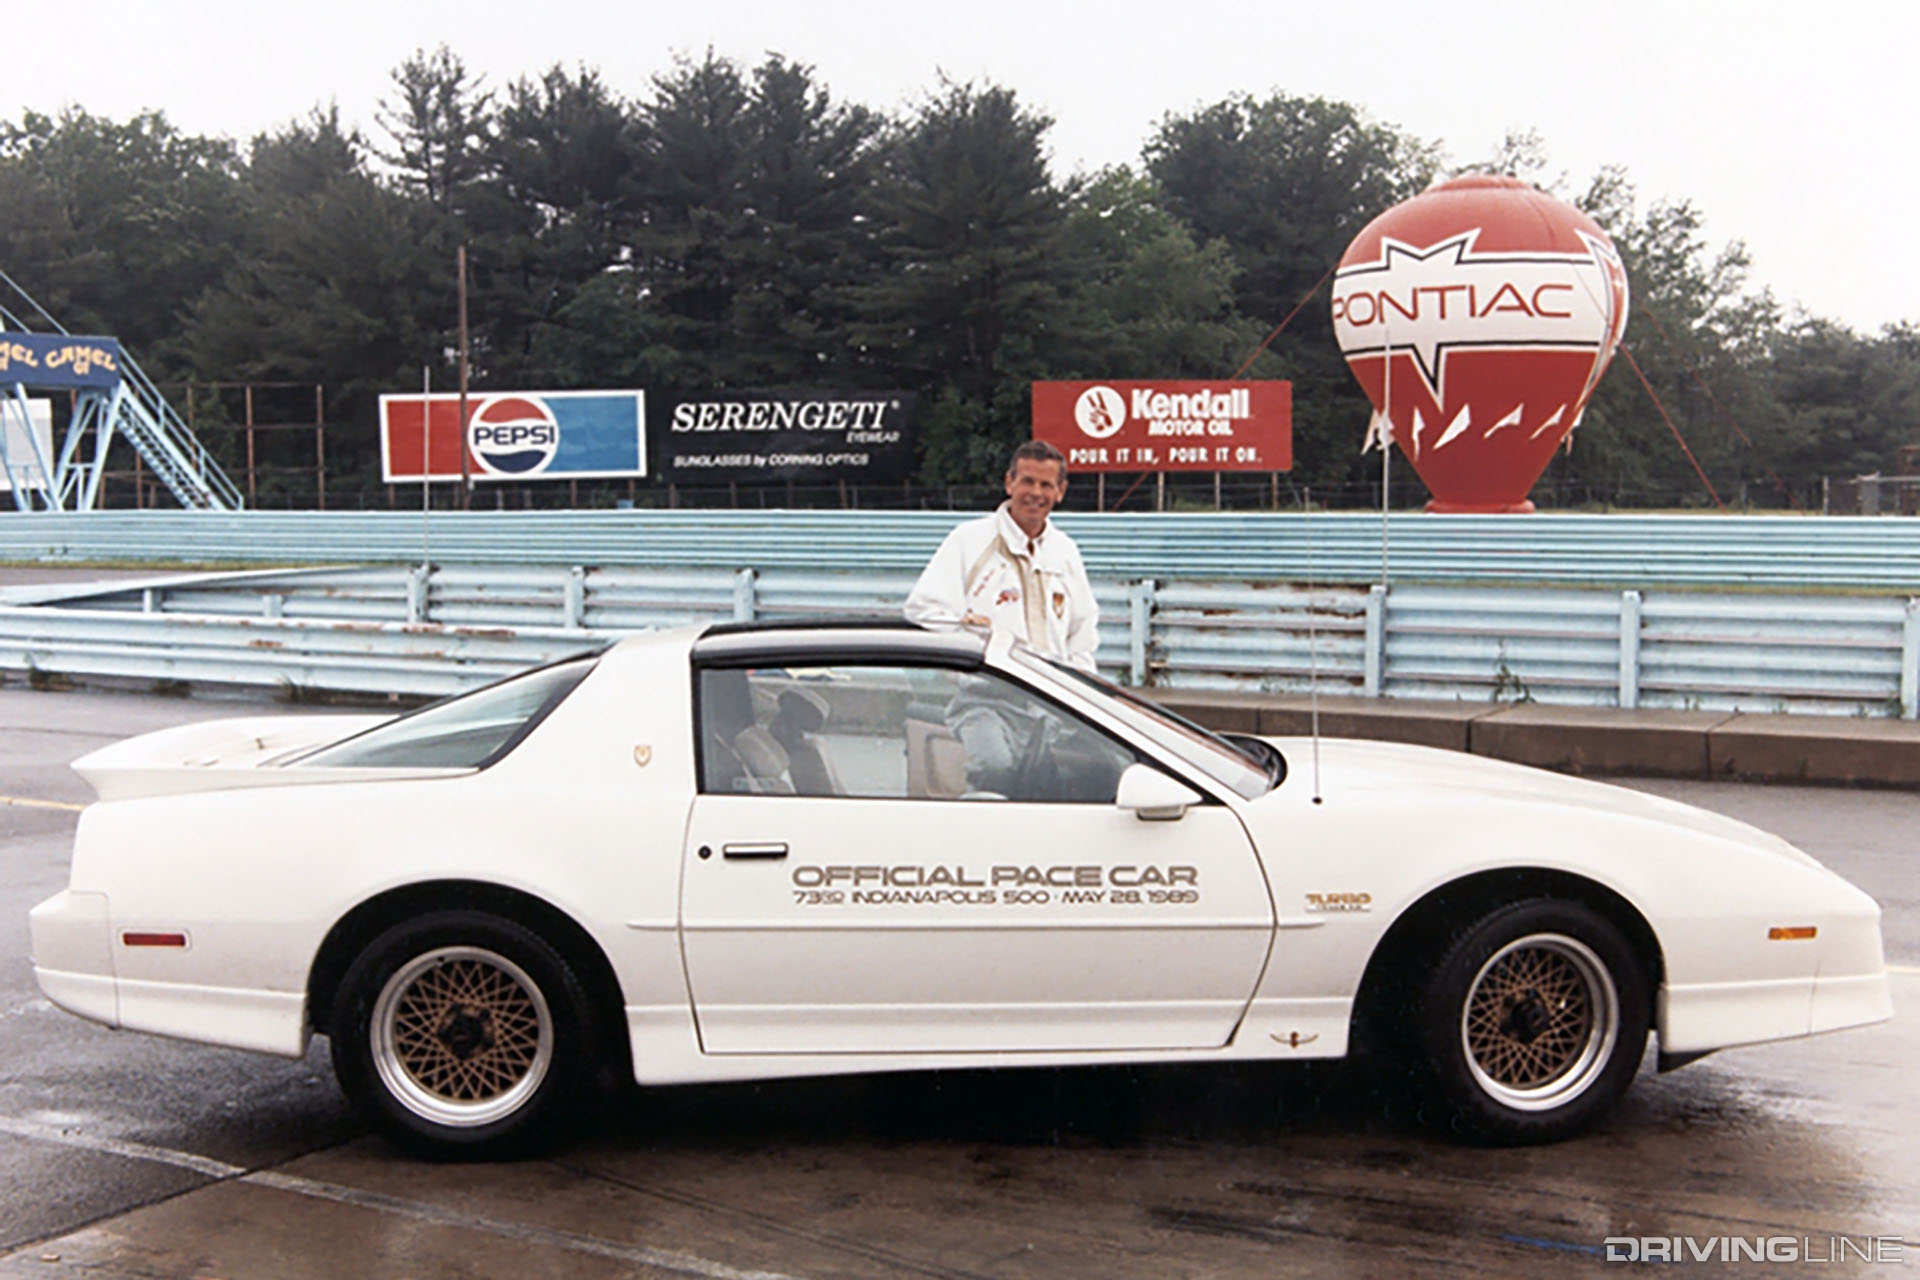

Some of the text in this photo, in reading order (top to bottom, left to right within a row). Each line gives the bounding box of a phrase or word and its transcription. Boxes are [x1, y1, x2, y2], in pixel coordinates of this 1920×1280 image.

[45, 346, 117, 371] CAMEL
[1131, 389, 1249, 419] Kendall
[671, 402, 886, 432] SERENGETI
[474, 425, 555, 445] PEPSI
[1148, 420, 1233, 436] MOTOR OIL
[846, 432, 900, 443] EYEWEAR
[673, 454, 751, 468] SUNGLASSES
[753, 455, 767, 467] by
[768, 453, 823, 466] CORNING
[1069, 448, 1109, 464] POUR
[1116, 448, 1130, 463] IT
[1169, 447, 1208, 463] POUR
[1215, 447, 1230, 462] IT
[792, 865, 1198, 887] OFFICIAL PACE CAR
[851, 890, 997, 905] INDIANAPOLIS
[1003, 890, 1050, 904] 500
[1062, 890, 1105, 904] MAY
[1148, 889, 1199, 904] 1989
[1305, 892, 1372, 905] TURBO
